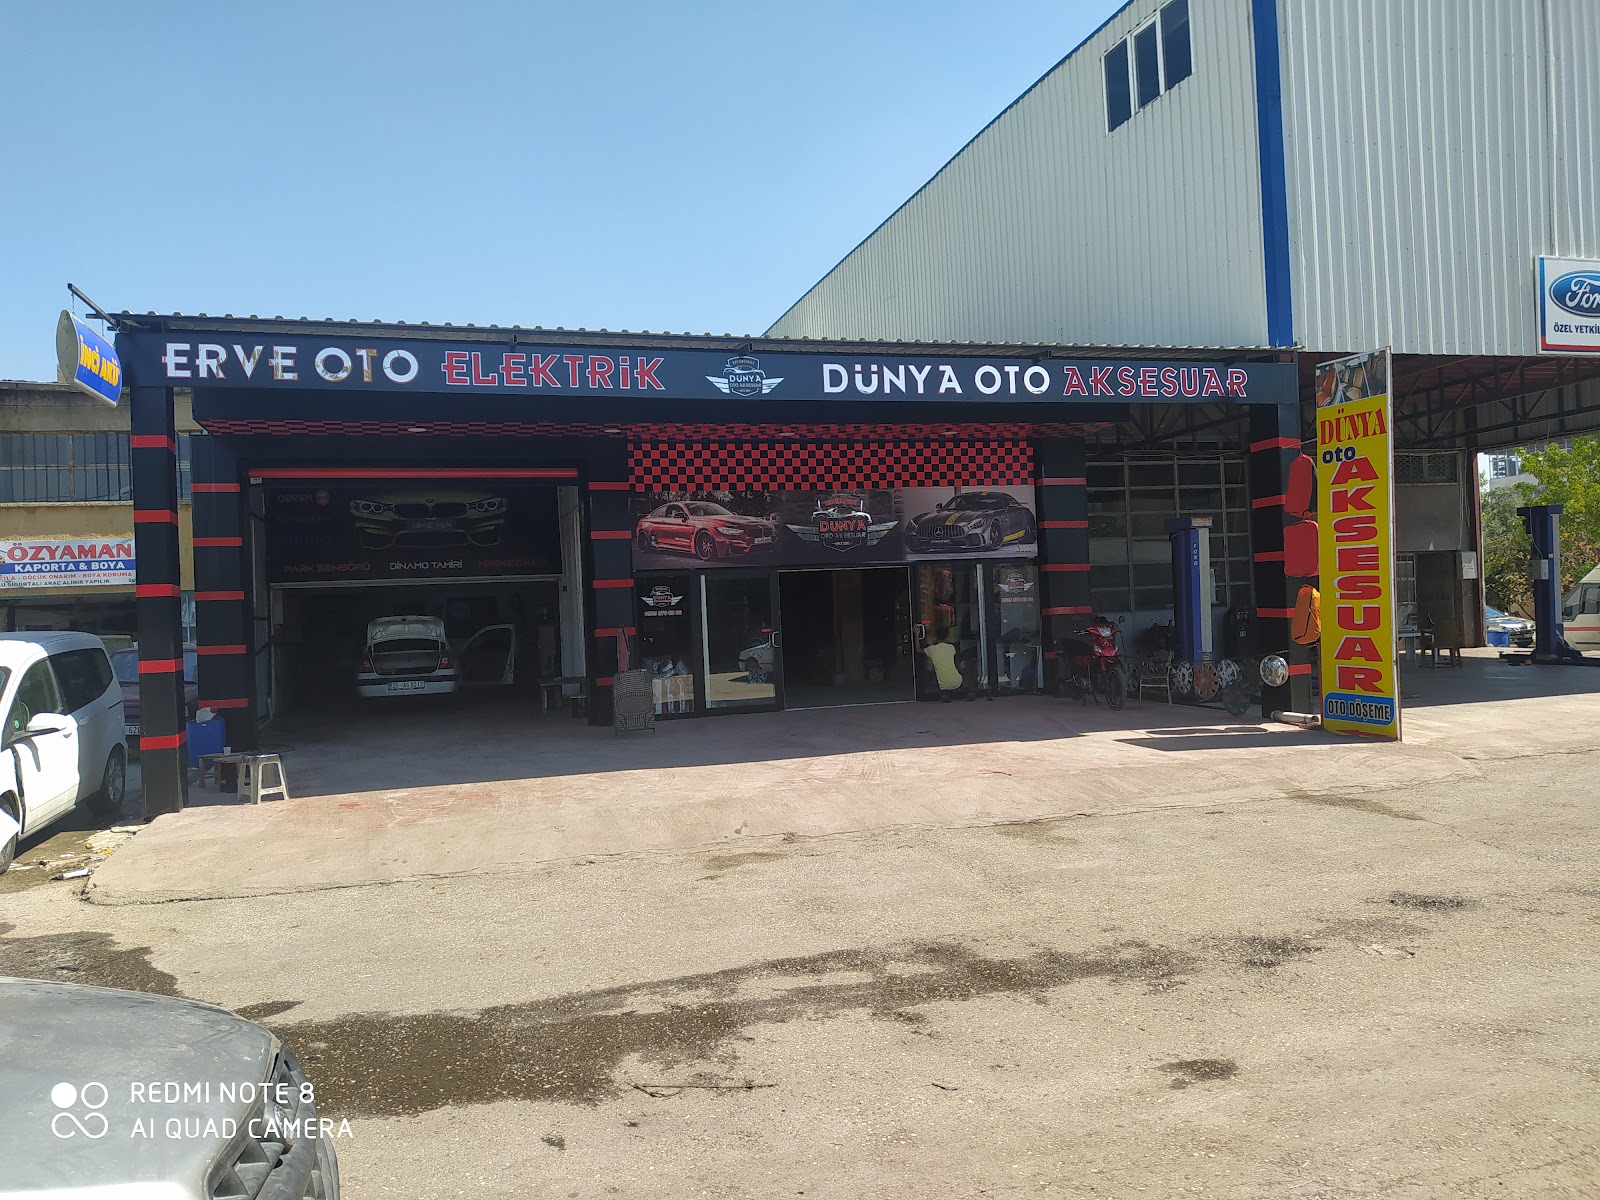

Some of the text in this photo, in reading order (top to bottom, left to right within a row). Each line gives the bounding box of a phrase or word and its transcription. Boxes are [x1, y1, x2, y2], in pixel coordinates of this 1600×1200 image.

[1553, 321, 1573, 333] ÖZEL
[161, 342, 419, 384] ERVE OTO
[729, 375, 761, 383] DÜNYA
[822, 363, 1051, 395] DÜNYA OTO
[1063, 366, 1248, 398] AKSESUAR
[1319, 407, 1388, 445] DÜNYA
[1322, 446, 1356, 464] oto
[7, 542, 132, 562] ÖZYAMAN
[15, 561, 125, 573] KAPORTA & BOYA
[389, 560, 429, 570] DİNAMO
[430, 559, 463, 569] TAMİRİ
[1330, 456, 1385, 693] AKSESUAR
[1327, 698, 1391, 722] OTO DÖŞEME
